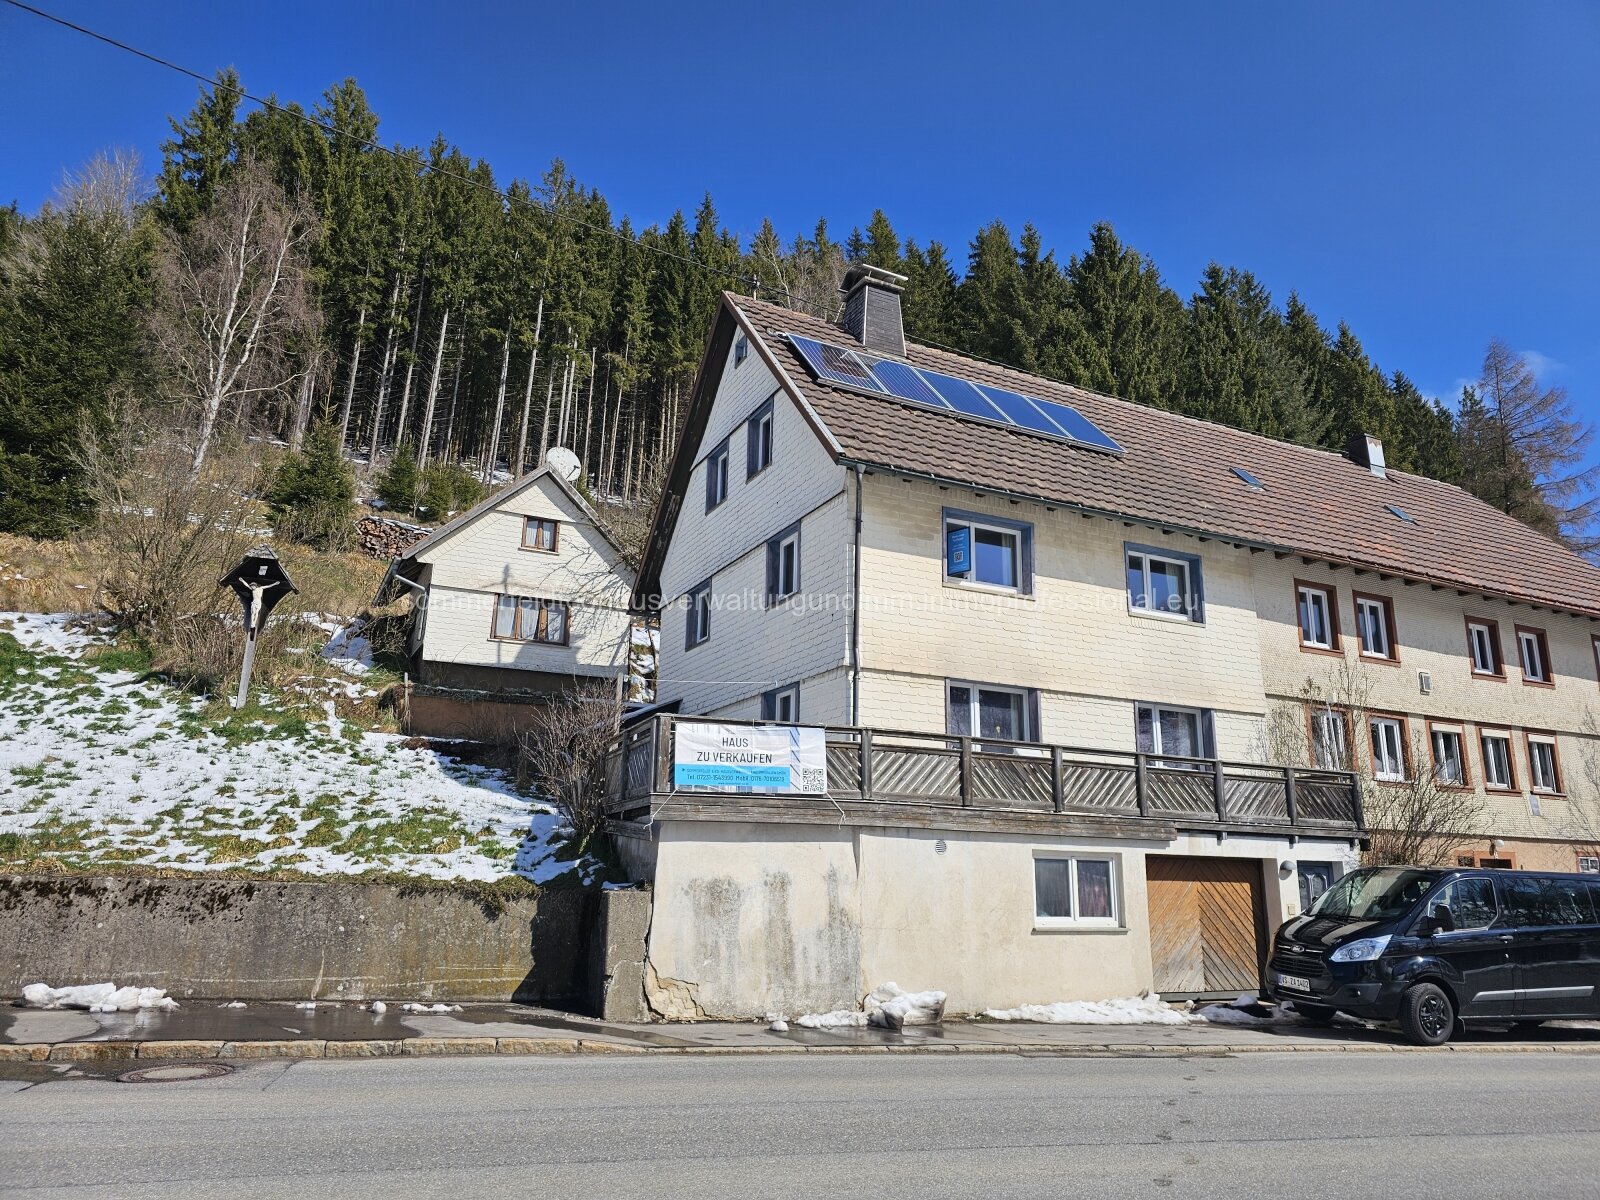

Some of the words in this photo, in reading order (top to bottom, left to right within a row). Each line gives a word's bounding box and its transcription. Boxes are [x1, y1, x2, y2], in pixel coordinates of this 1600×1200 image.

[722, 737, 749, 748] HAUS
[697, 751, 710, 761] ZU
[713, 752, 772, 763] VERKAUFEN
